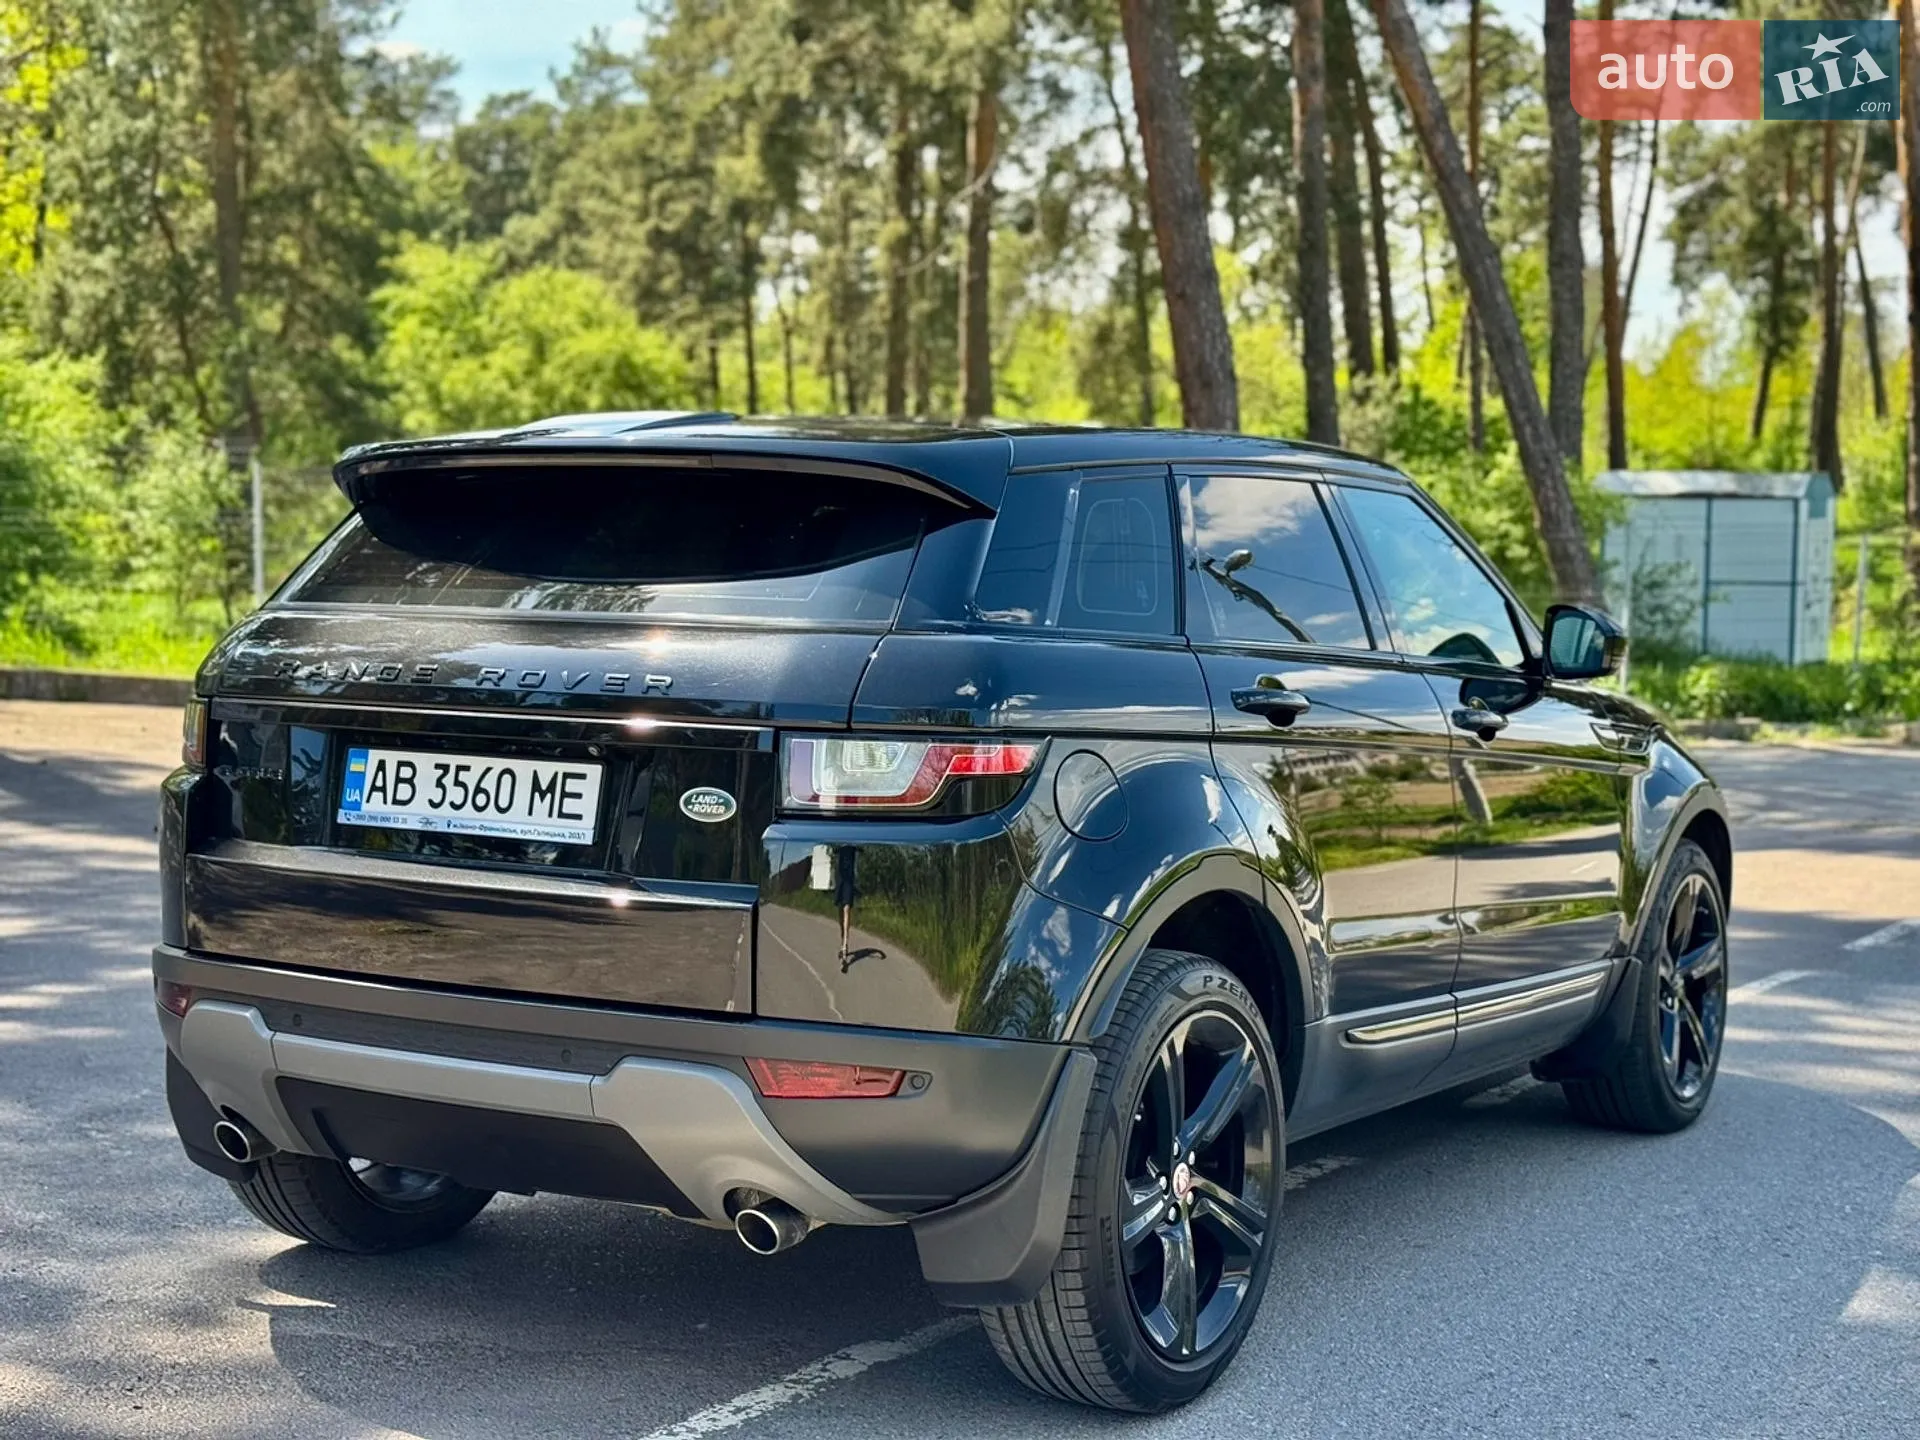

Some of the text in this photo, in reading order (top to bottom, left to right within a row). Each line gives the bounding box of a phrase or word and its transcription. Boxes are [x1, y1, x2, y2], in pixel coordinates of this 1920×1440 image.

[274, 660, 674, 696] RANGE ROVER
[346, 788, 360, 802] UA
[366, 759, 587, 820] AB 3560 ME
[691, 794, 718, 804] LAND
[692, 804, 725, 814] ROVER
[1203, 975, 1258, 1018] P ZERO
